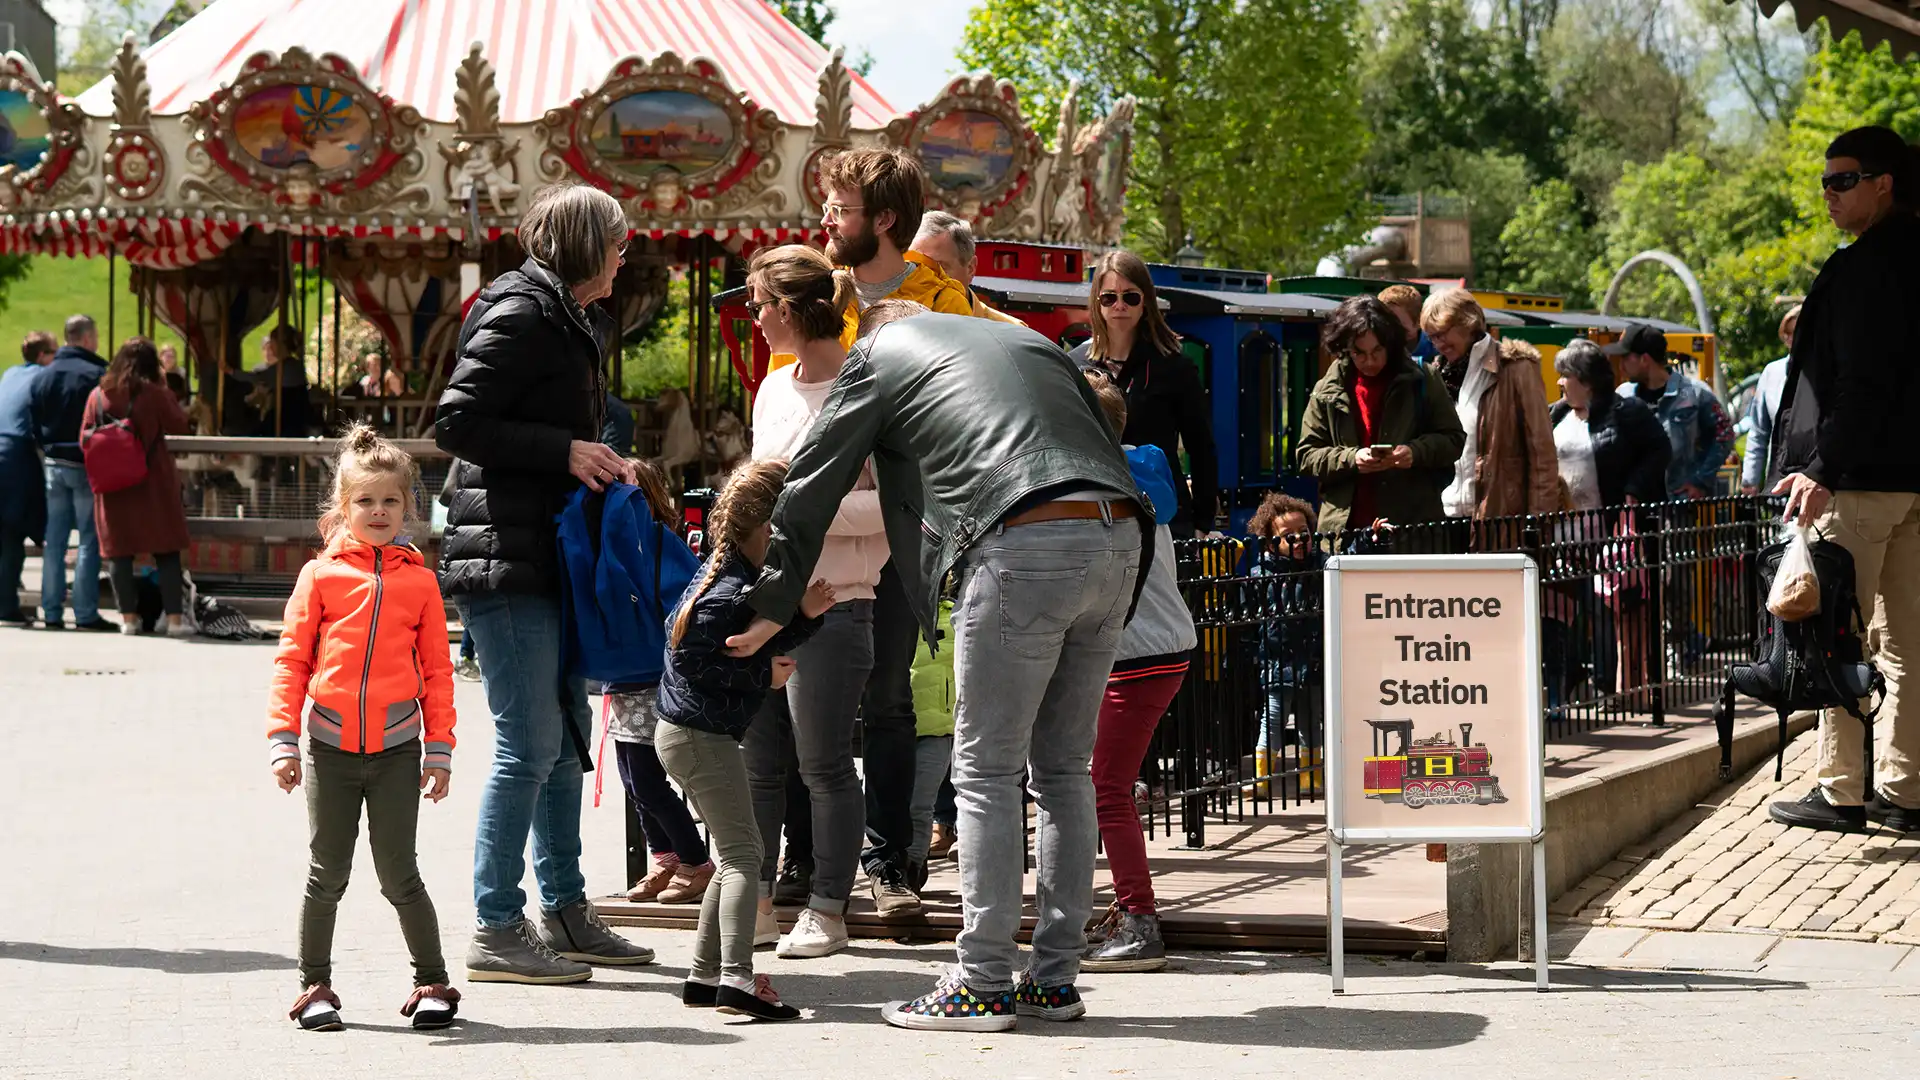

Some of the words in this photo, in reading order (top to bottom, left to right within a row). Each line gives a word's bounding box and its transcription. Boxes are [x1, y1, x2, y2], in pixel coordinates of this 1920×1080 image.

[1365, 593, 1502, 620] Entrance
[1395, 634, 1471, 662] Train
[1379, 677, 1488, 706] Station
